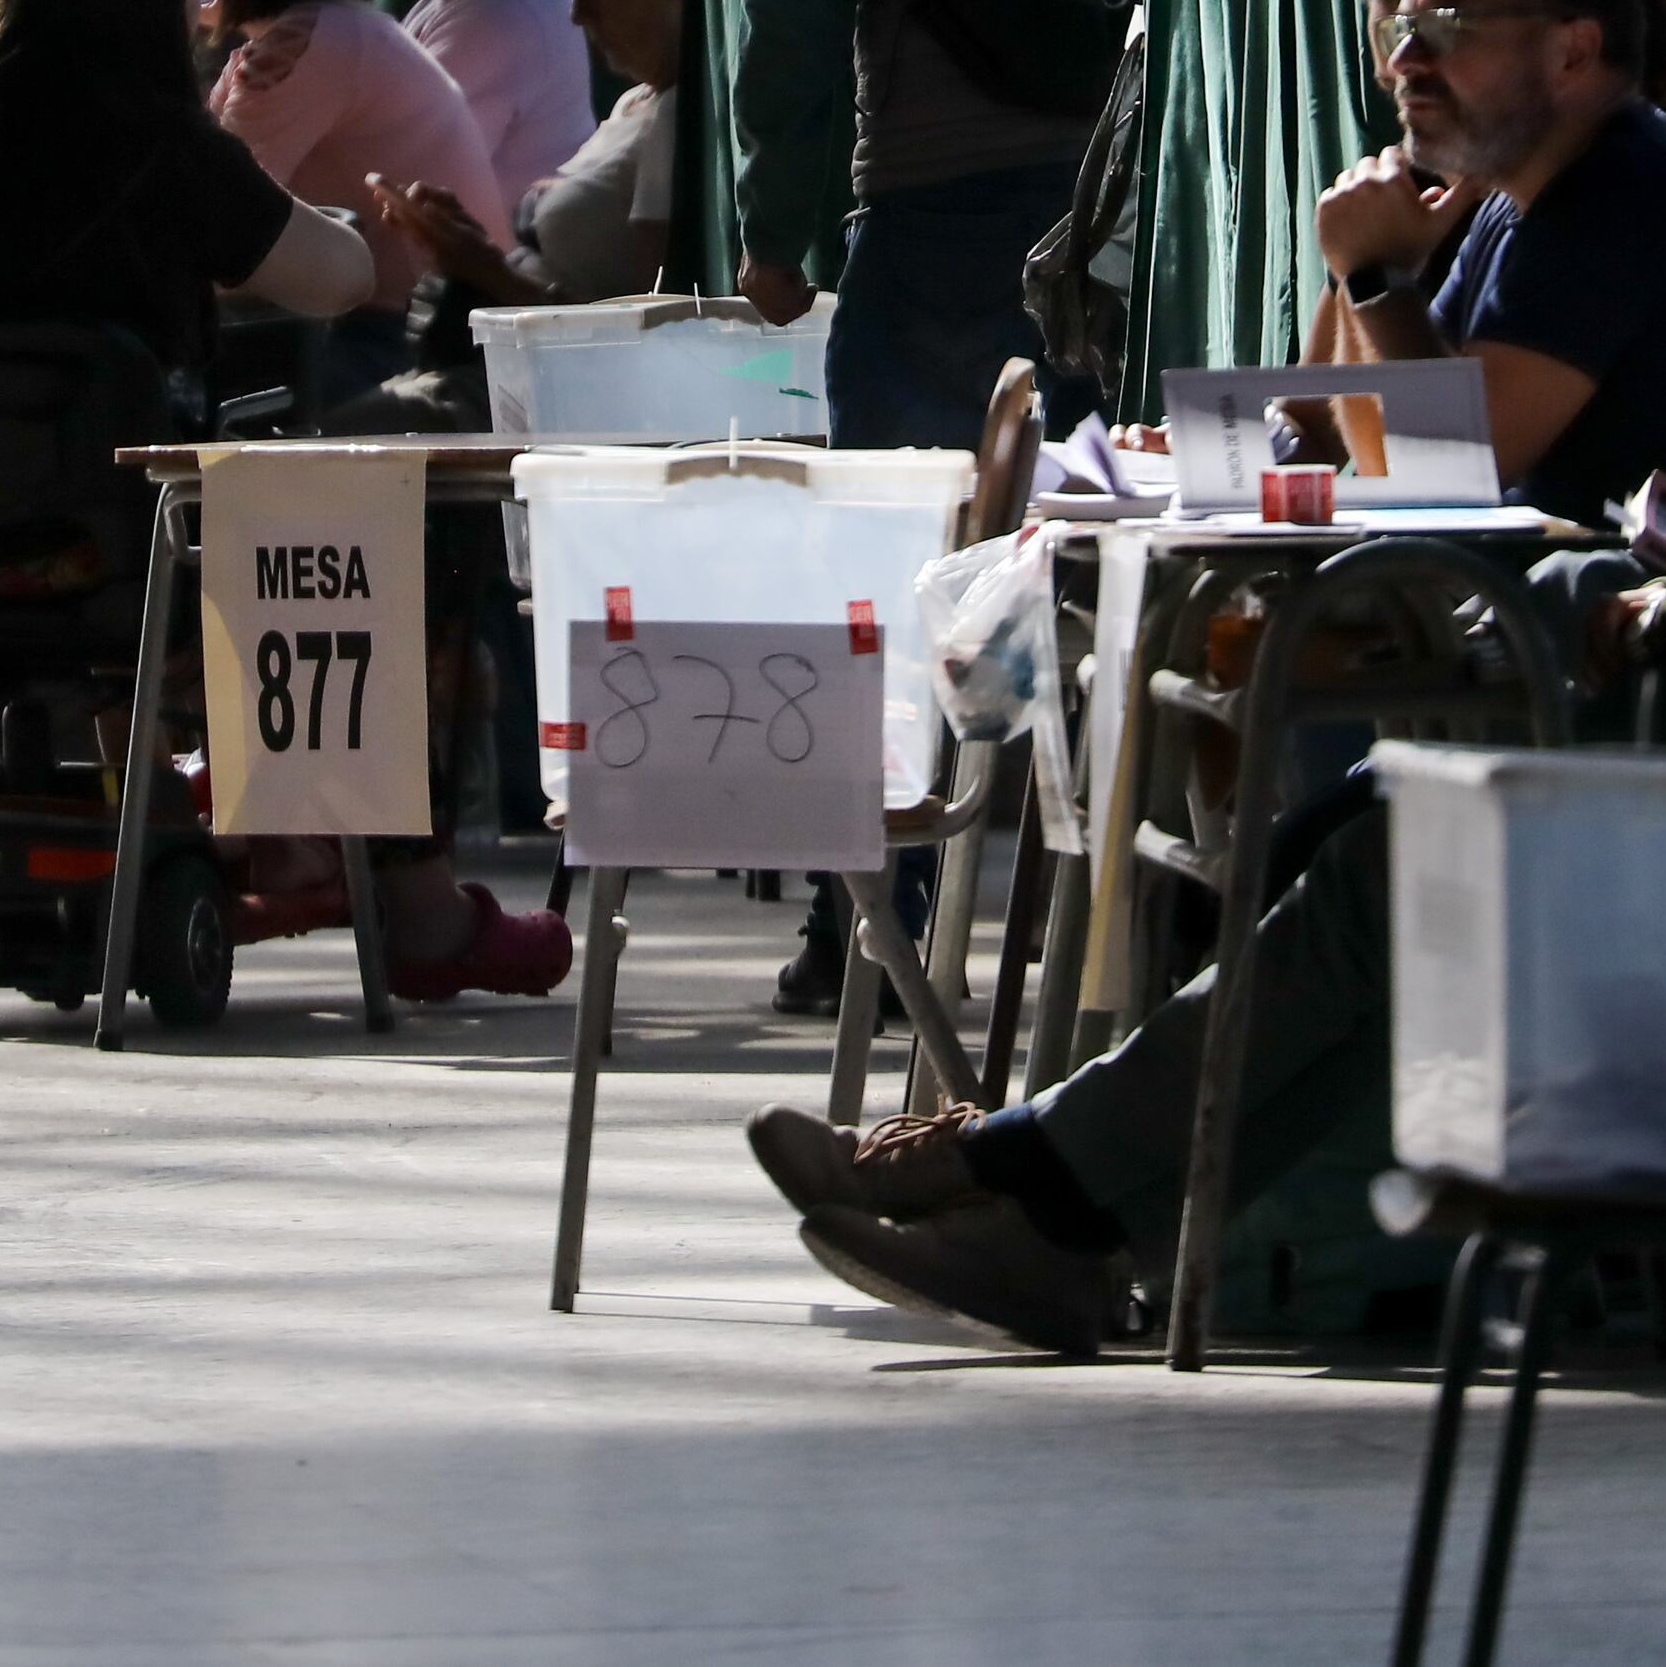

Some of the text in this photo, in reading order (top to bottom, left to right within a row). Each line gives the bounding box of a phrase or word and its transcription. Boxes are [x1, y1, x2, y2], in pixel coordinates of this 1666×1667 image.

[255, 545, 371, 599] MESA
[256, 629, 372, 752] 877
[594, 647, 820, 769] 878
